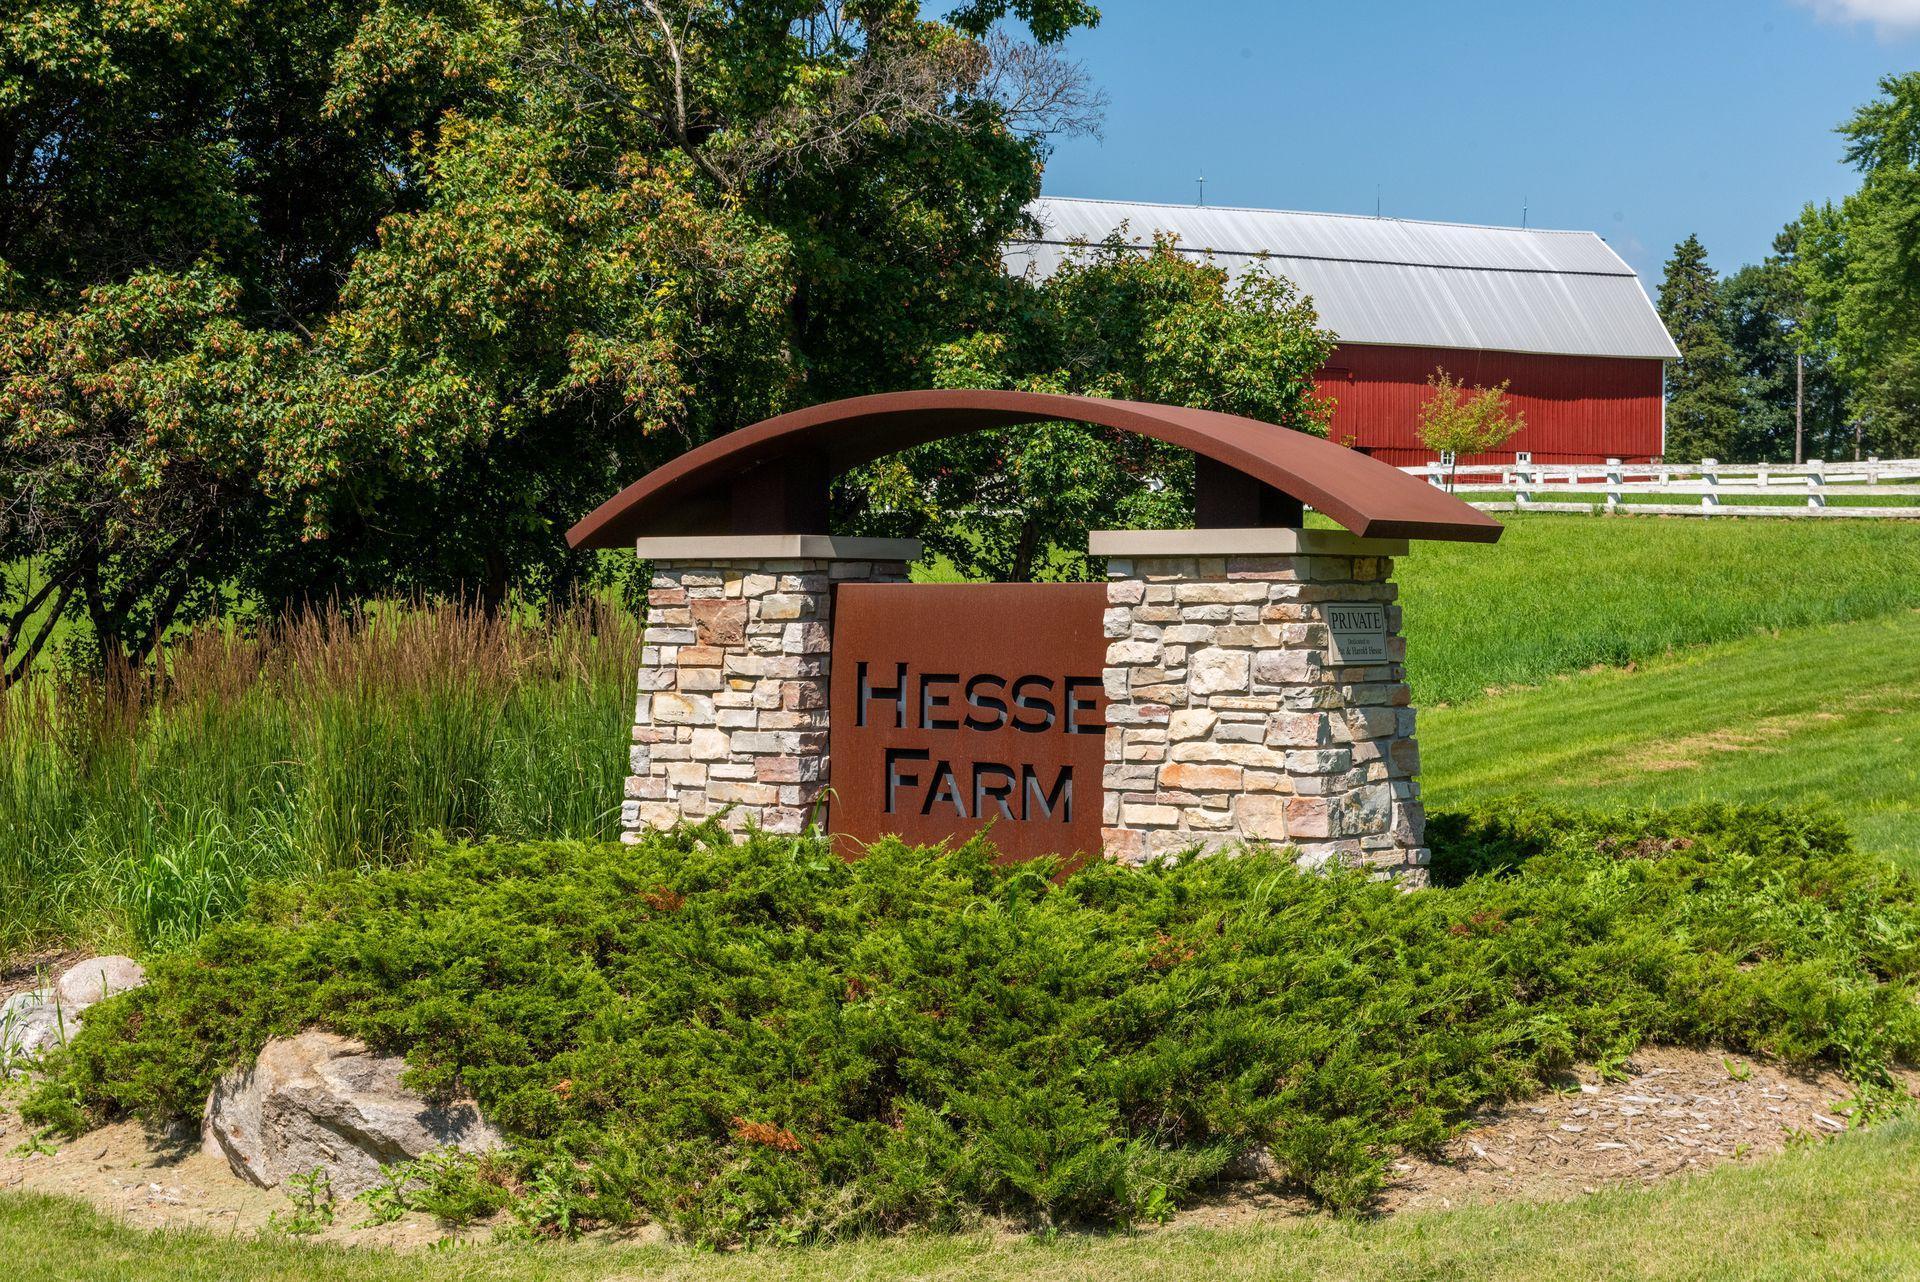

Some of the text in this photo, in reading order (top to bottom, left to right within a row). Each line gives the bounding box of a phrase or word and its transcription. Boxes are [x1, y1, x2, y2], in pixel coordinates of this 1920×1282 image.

[1331, 612, 1382, 629] PRIVATE
[855, 661, 1107, 735] HESSE
[883, 747, 1074, 823] FARM
